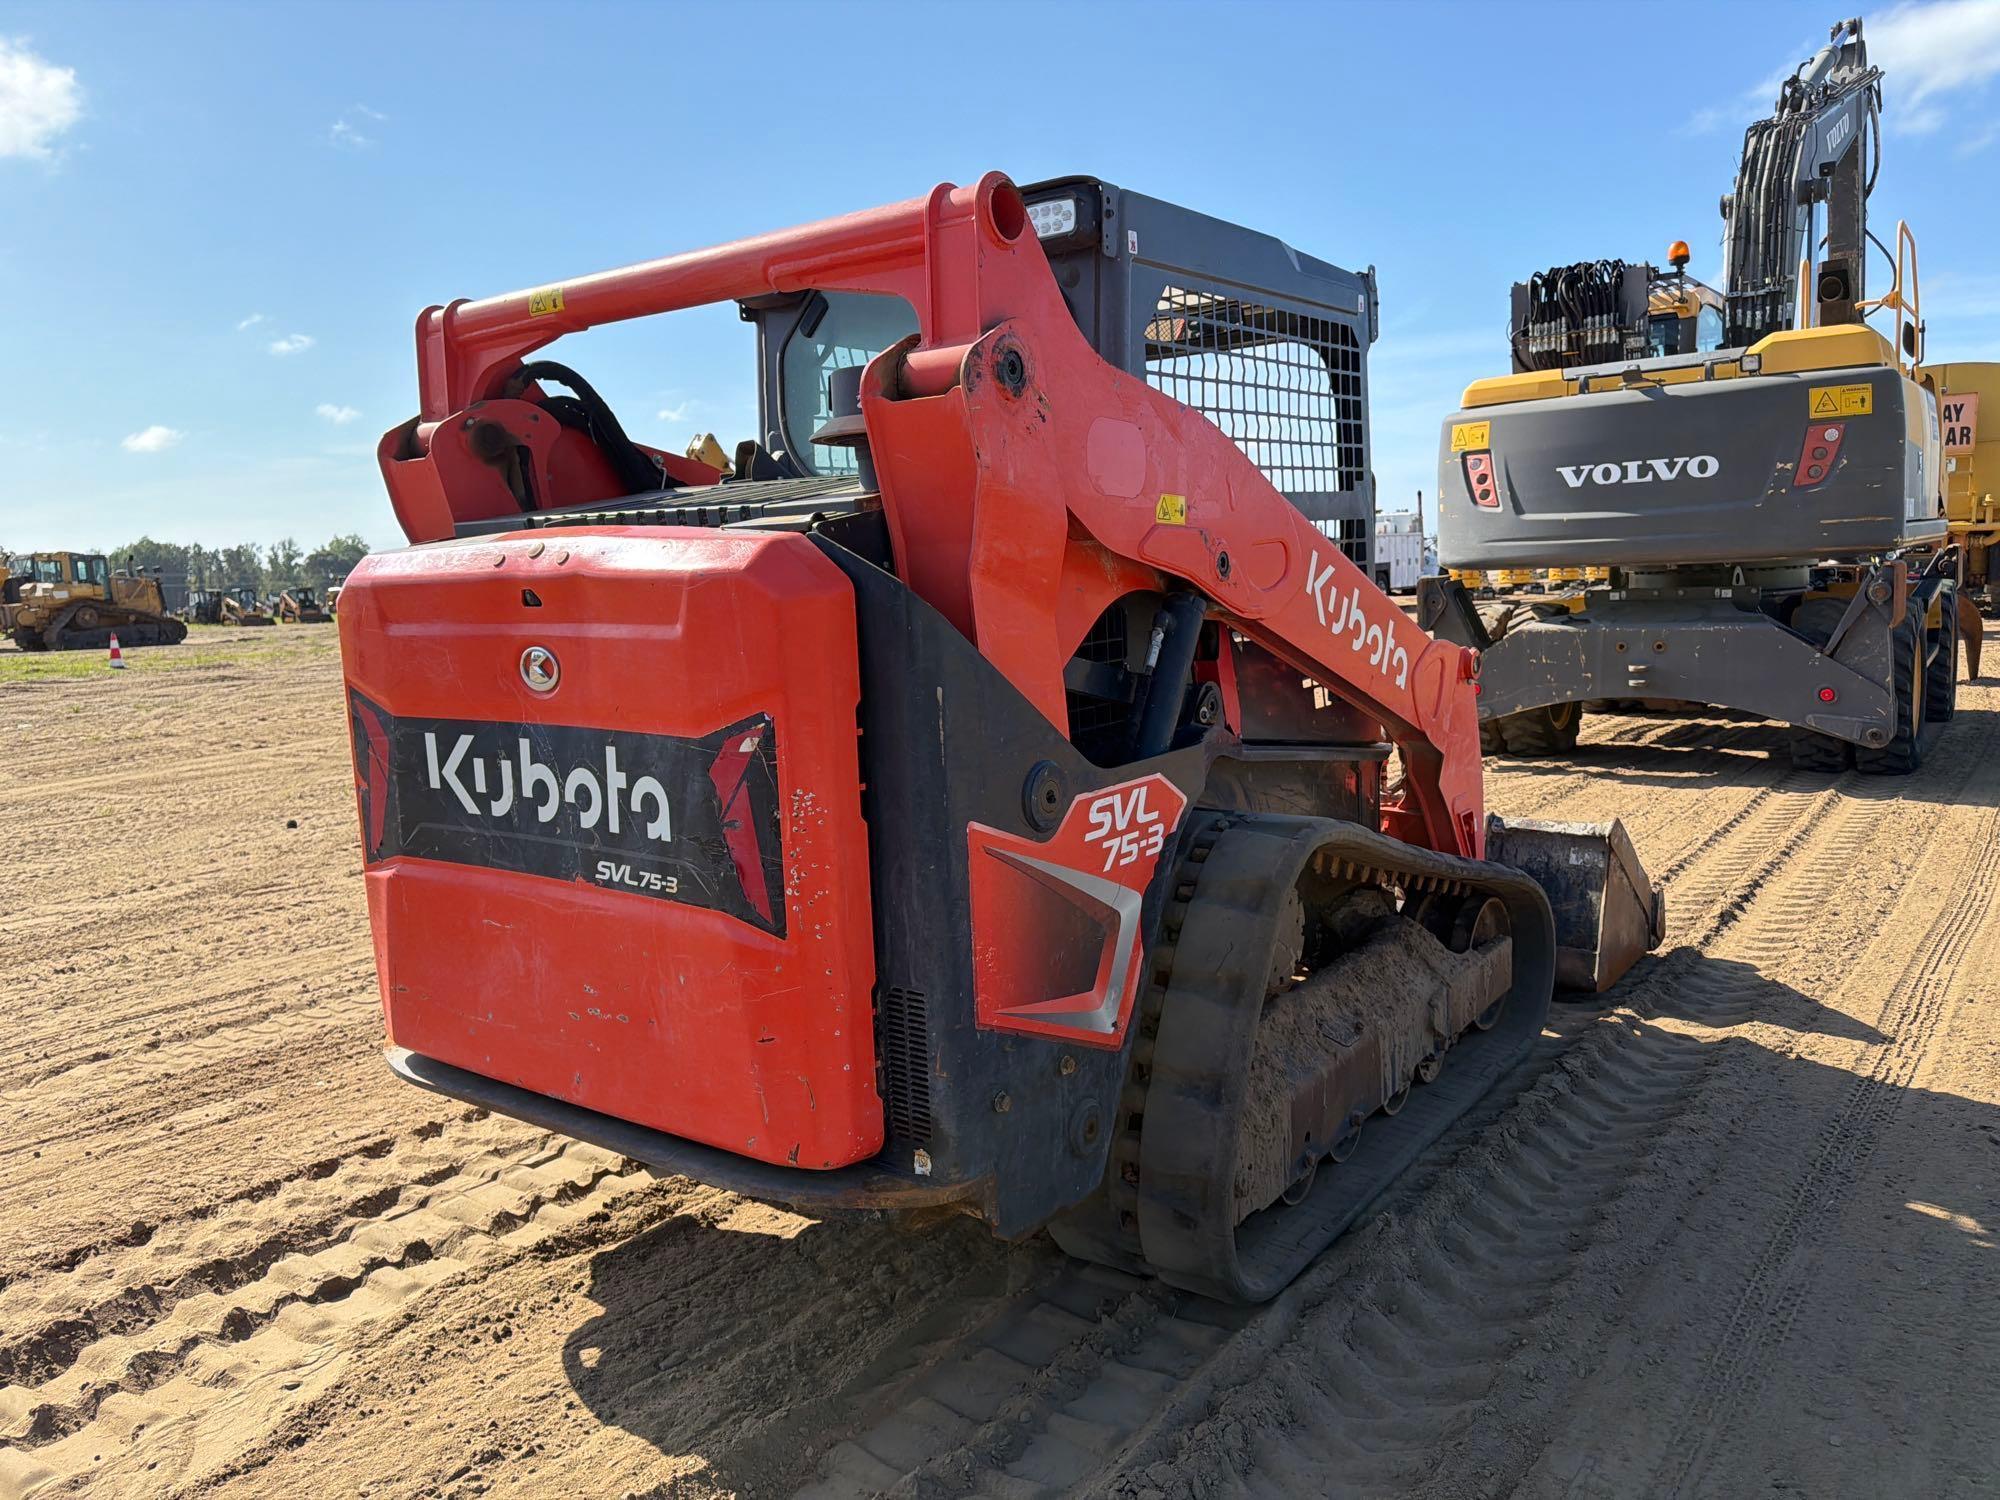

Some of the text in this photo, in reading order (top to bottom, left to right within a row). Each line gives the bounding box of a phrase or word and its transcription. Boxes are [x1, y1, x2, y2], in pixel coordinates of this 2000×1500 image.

[1943, 403, 1965, 423] AY
[1945, 426, 1971, 446] AR
[1556, 455, 1719, 487] VOLVO
[1306, 550, 1408, 690] Kubota
[424, 732, 671, 842] Kubota
[1085, 786, 1159, 841] SVL
[1102, 823, 1164, 872] 75-3
